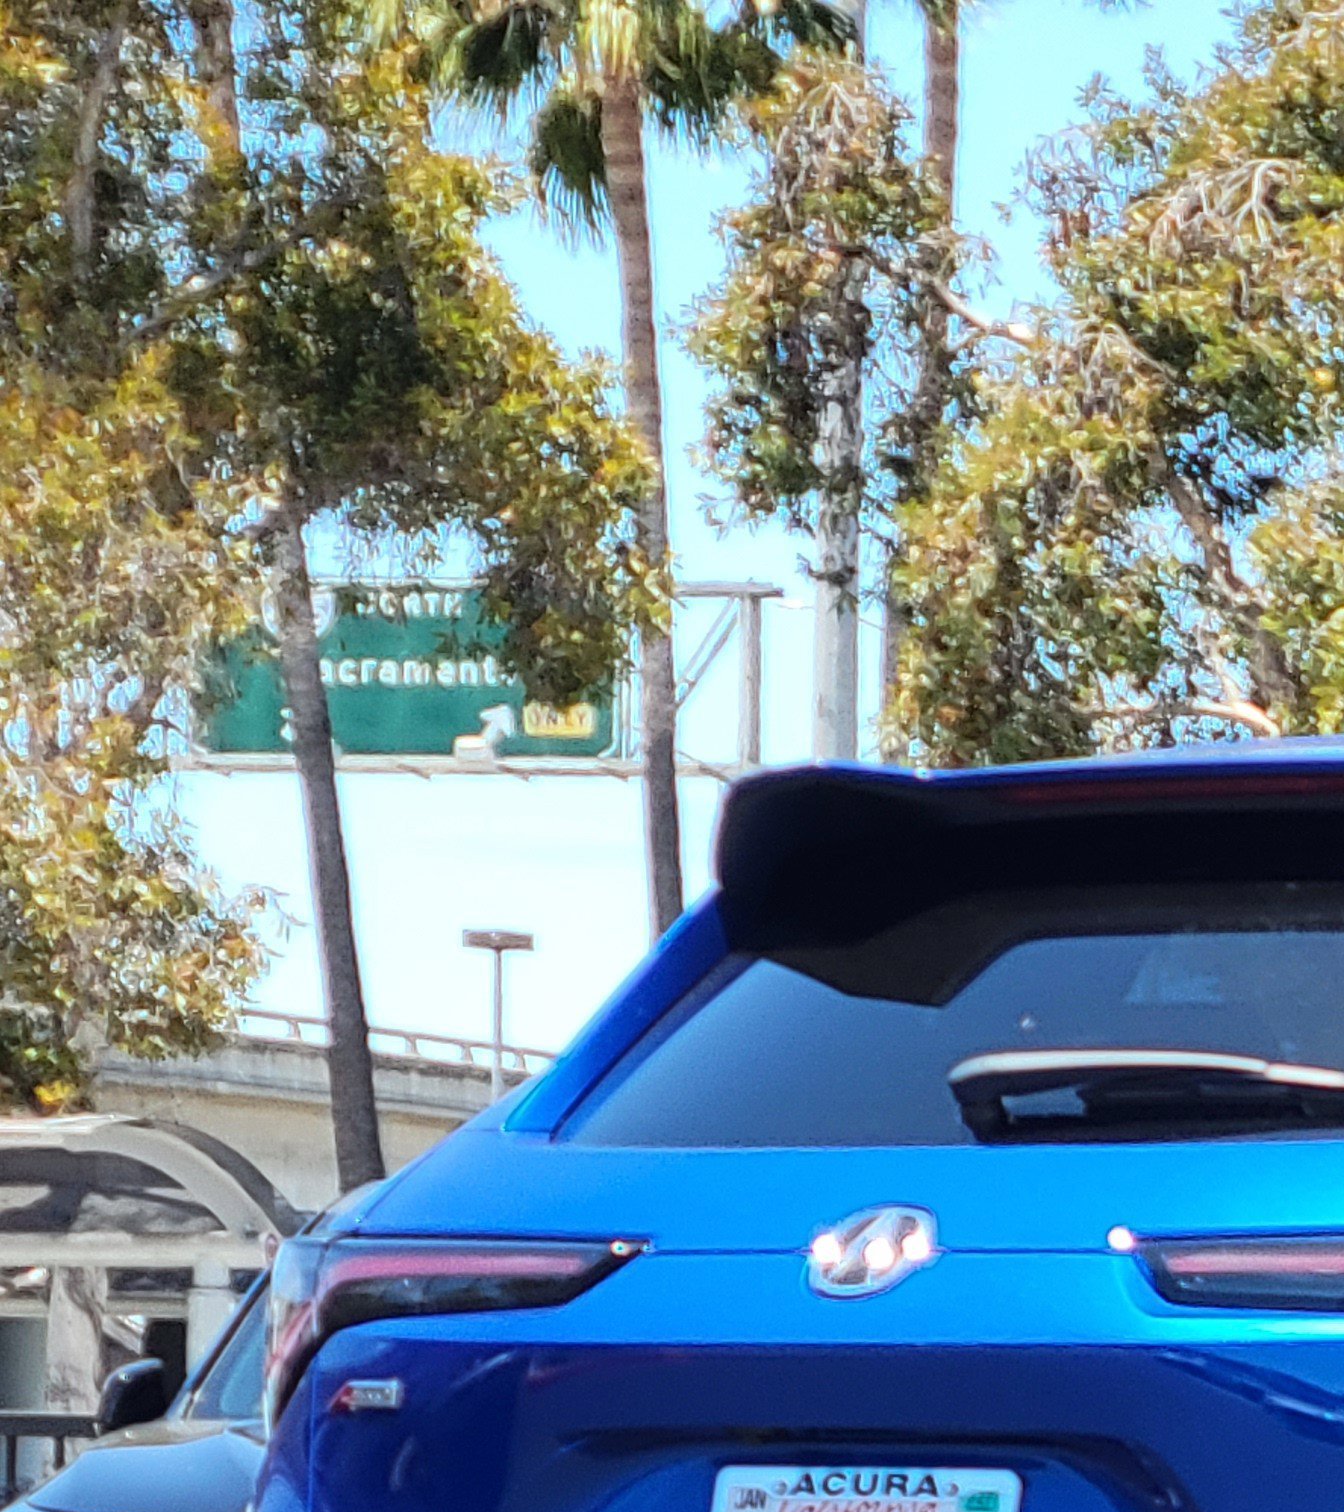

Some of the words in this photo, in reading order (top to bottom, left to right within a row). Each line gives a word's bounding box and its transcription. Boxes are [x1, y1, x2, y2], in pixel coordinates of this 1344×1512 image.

[319, 655, 518, 686] acrament
[792, 1473, 940, 1497] ACURA
[734, 1488, 767, 1510] JAN
